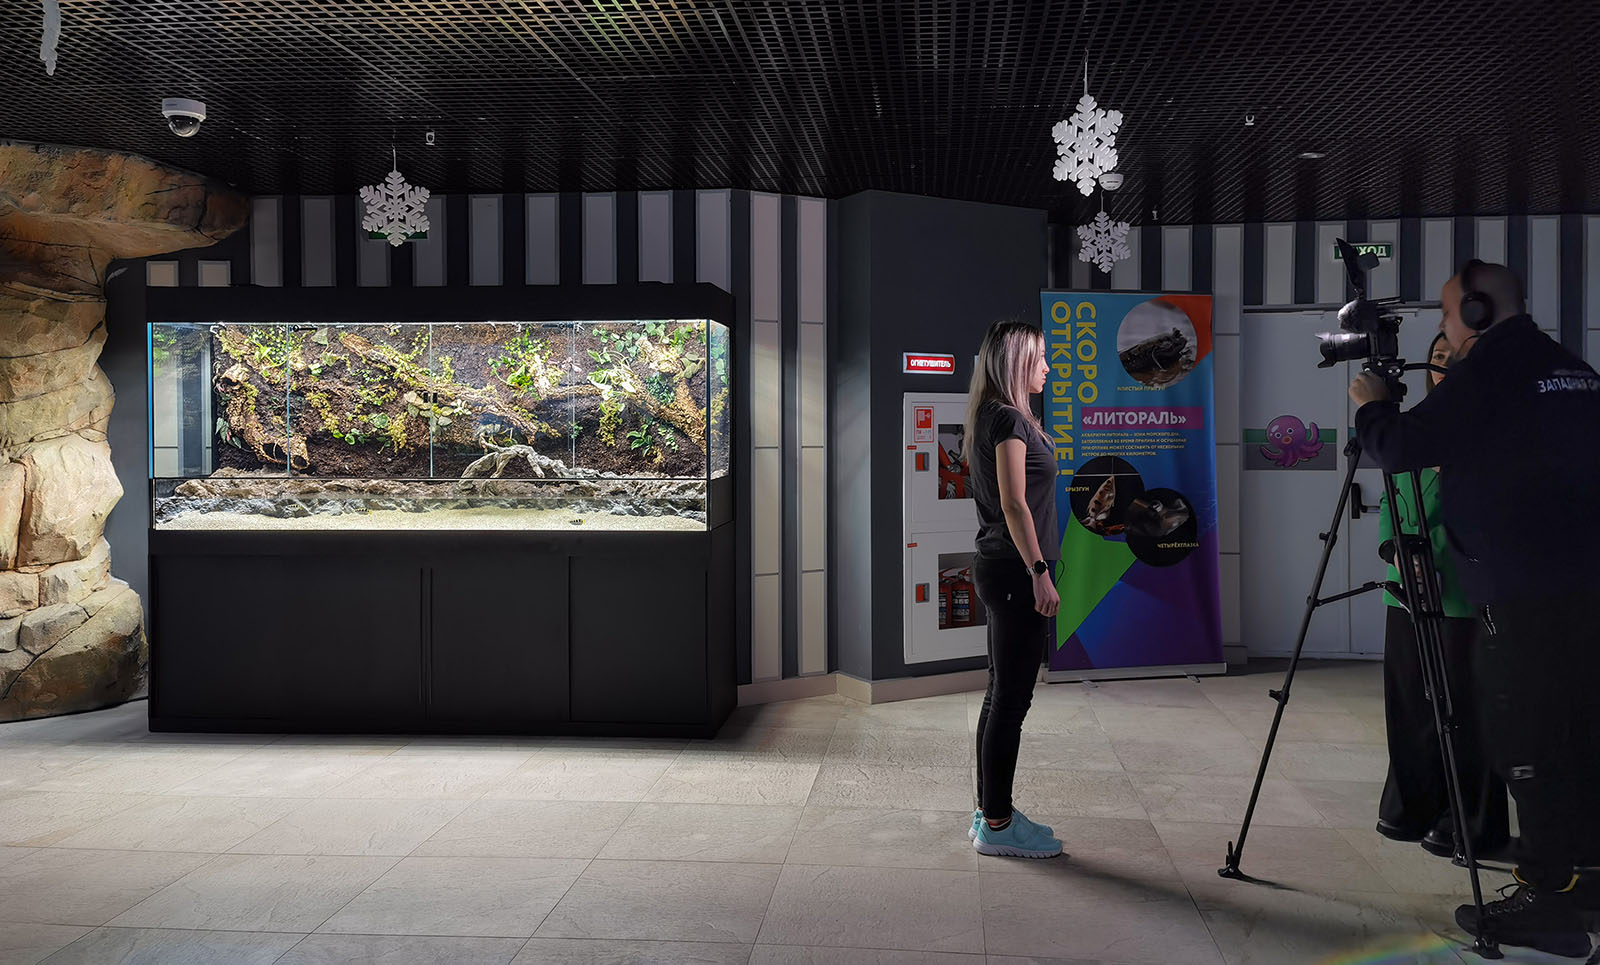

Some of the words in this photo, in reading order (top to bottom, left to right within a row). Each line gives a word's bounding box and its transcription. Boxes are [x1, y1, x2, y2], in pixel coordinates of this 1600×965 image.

[1051, 301, 1074, 461] ОТКРЫТИЕ
[1076, 301, 1098, 404] СКОРО
[1082, 411, 1187, 425] «ЛИТОРАЛЬ»
